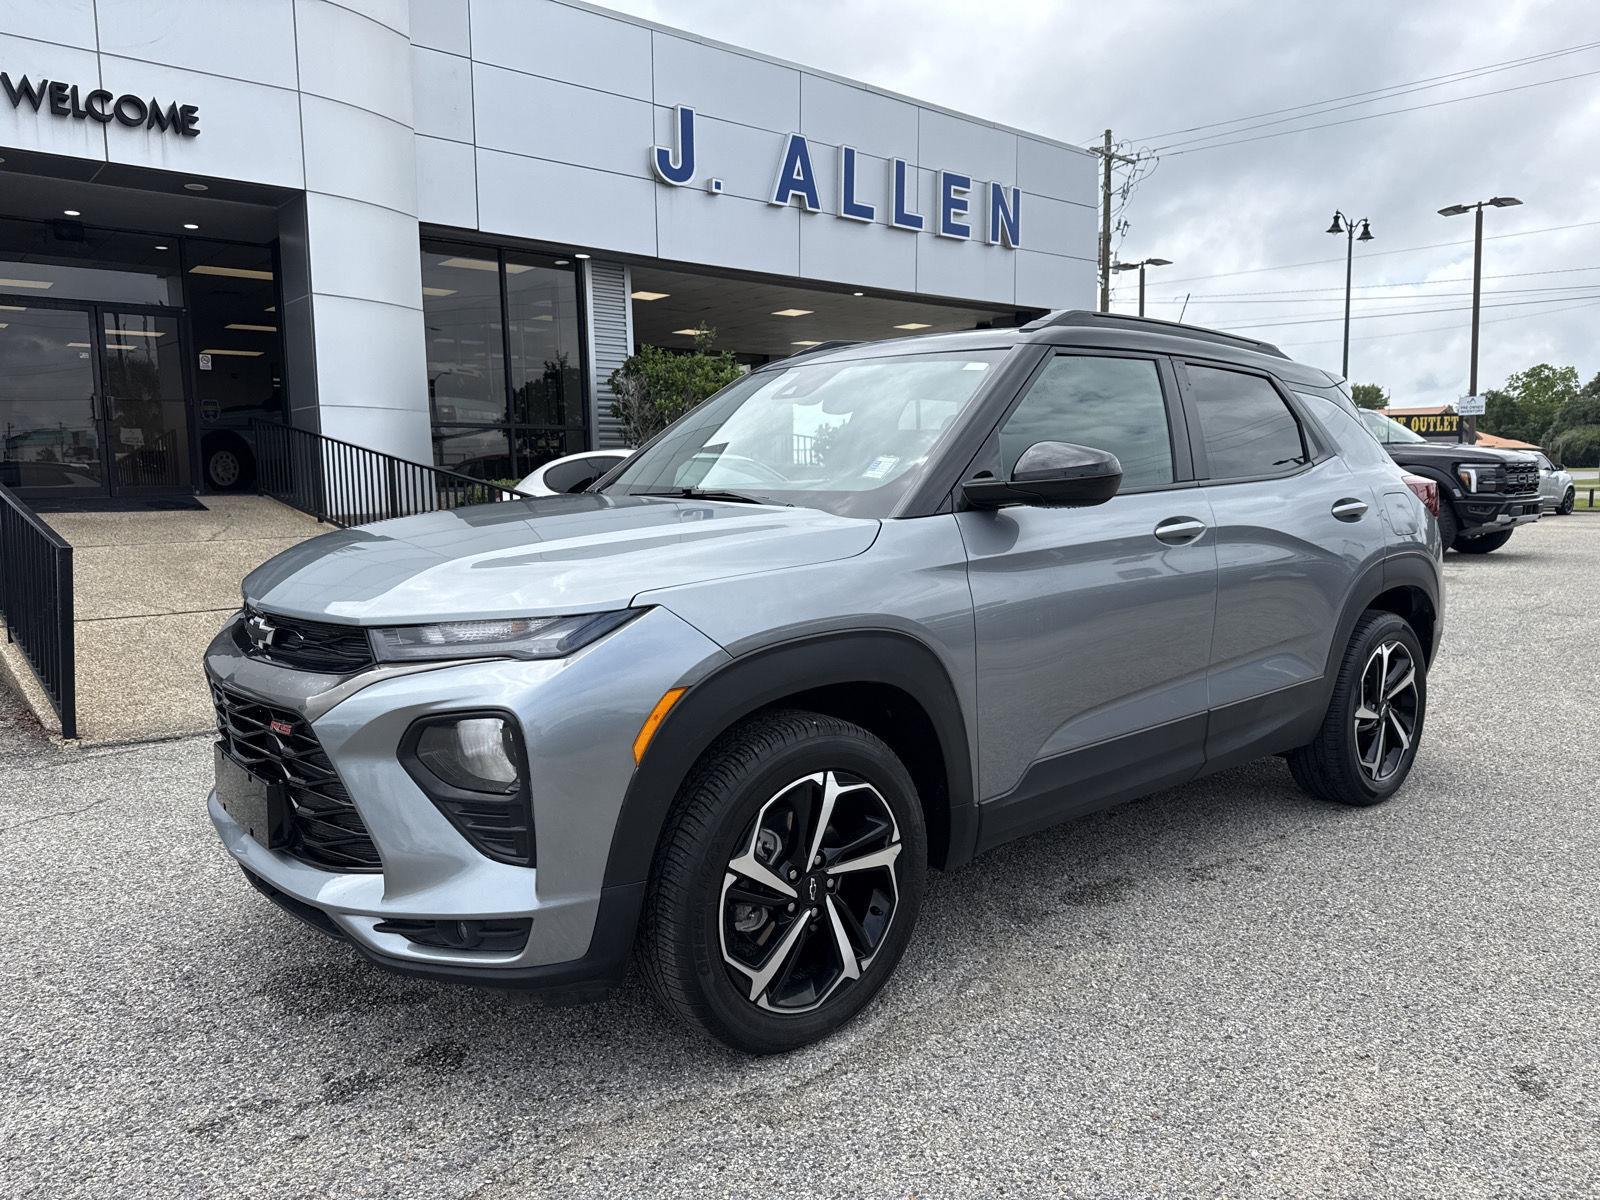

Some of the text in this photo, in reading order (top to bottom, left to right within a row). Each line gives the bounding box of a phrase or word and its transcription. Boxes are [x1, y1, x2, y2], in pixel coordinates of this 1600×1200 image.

[1, 72, 200, 137] WELCOME
[650, 104, 1022, 249] J. ALLEN
[1410, 415, 1460, 432] OUTLET
